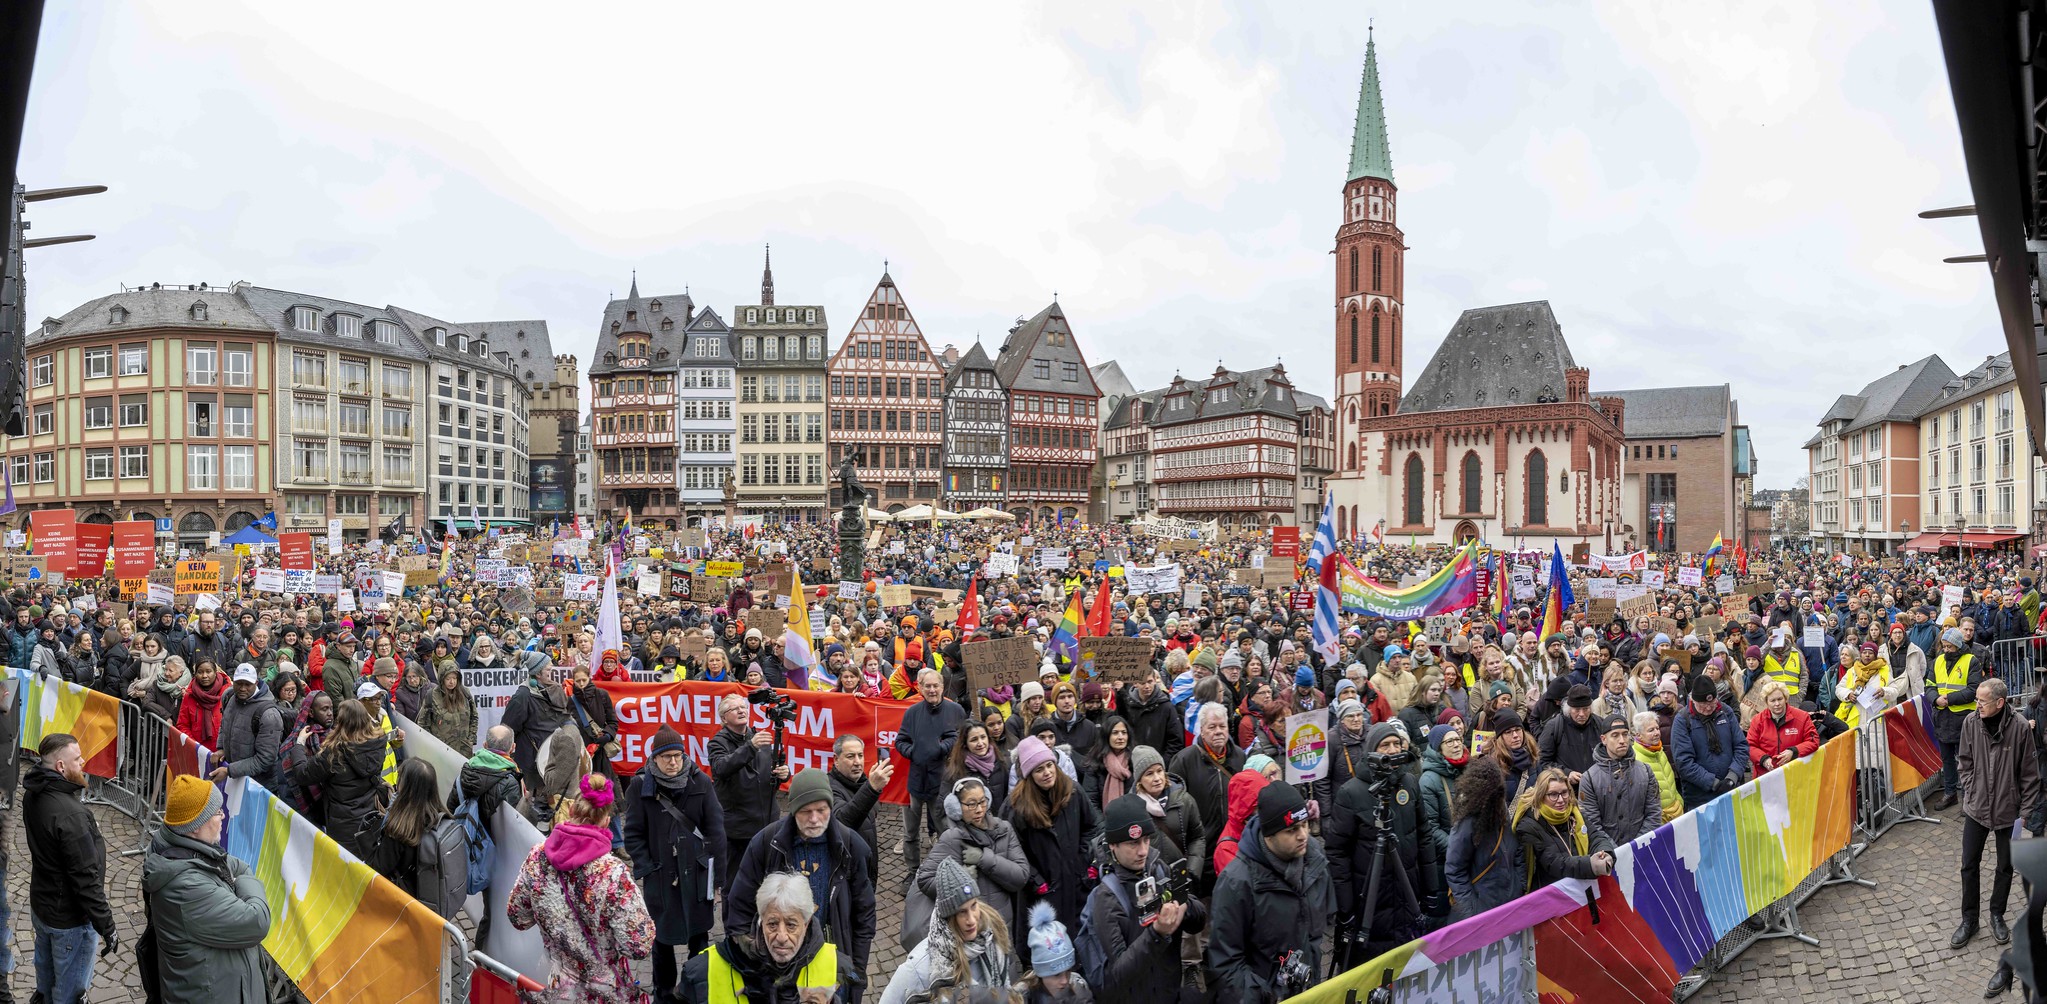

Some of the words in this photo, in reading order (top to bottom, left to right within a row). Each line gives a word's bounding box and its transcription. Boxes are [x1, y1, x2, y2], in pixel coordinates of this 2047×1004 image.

[162, 519, 172, 530] U
[1156, 518, 1171, 526] ALLE
[1146, 523, 1166, 536] GEGEN
[1166, 526, 1178, 538] DEN
[188, 562, 207, 571] KEIN
[708, 561, 735, 570] Windräder
[567, 574, 586, 583] ALICE
[672, 576, 690, 588] FCK
[176, 584, 192, 593] FÜR
[192, 584, 217, 592] NAZIS
[671, 585, 690, 595] AFD
[1602, 590, 1616, 598] 1933
[565, 592, 596, 600] WUNDERLAND
[841, 590, 858, 600] RAUS!
[1342, 592, 1364, 608] and
[1367, 602, 1428, 618] equality
[964, 644, 977, 655] ES
[991, 640, 1009, 652] NICHT
[980, 654, 986, 664] 5
[993, 650, 1009, 661] VOR
[975, 662, 1007, 675] SONDERN
[474, 694, 493, 708] Für
[878, 730, 898, 746] SP
[1296, 733, 1321, 746] STIMME
[1292, 744, 1311, 756] GEGEN
[1301, 752, 1317, 767] AFD
